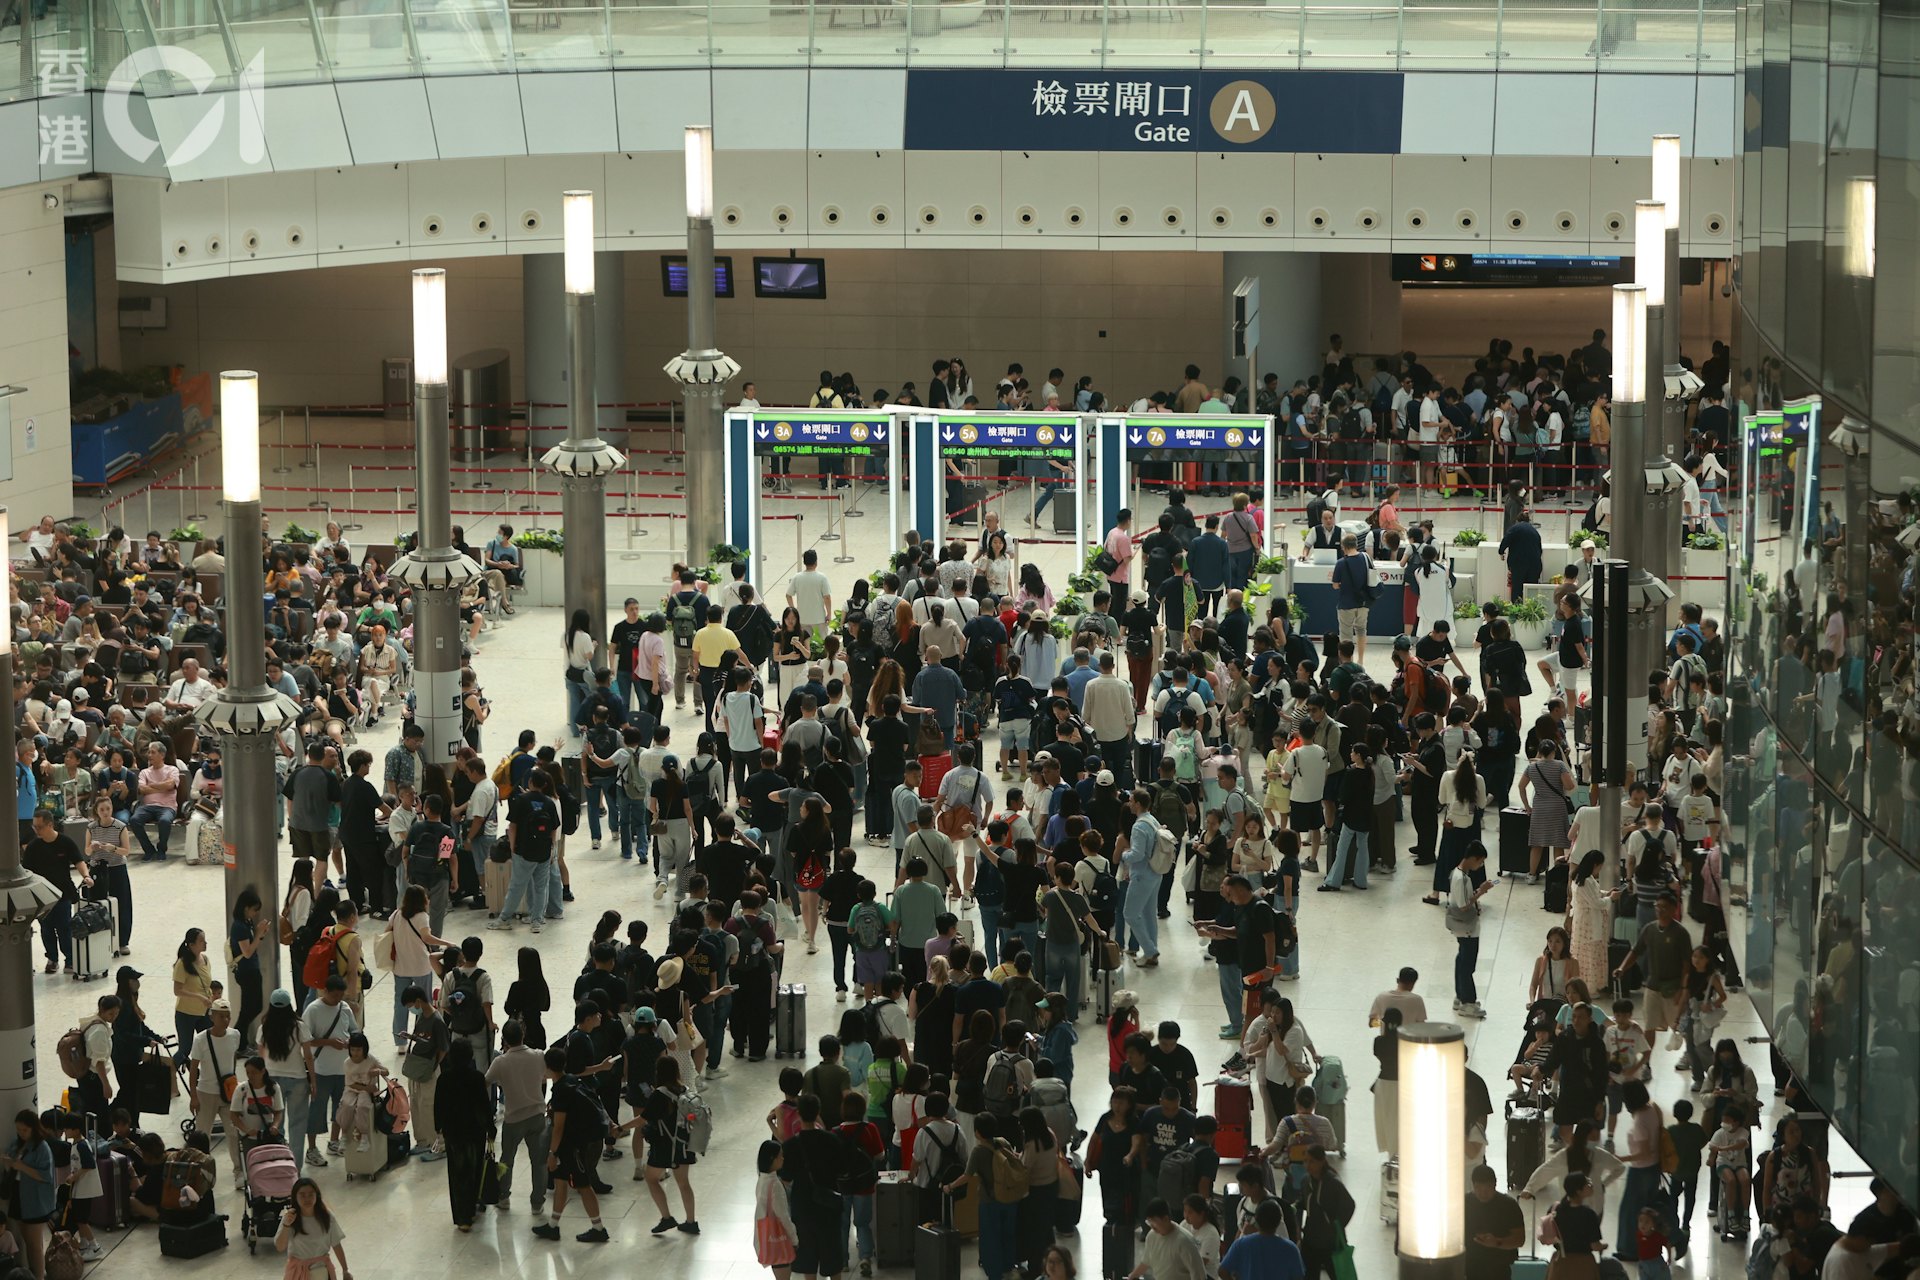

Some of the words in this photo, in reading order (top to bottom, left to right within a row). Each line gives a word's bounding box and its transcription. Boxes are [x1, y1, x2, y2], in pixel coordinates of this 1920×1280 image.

[1031, 80, 1192, 117] 檢票閘口
[1224, 90, 1260, 131] A
[1135, 122, 1190, 142] Gate
[1443, 258, 1456, 269] 3A
[776, 426, 790, 437] 3A
[802, 423, 841, 434] 檢票閘口
[852, 427, 867, 438] 4A
[962, 428, 976, 440] 5A
[987, 426, 1027, 437] 檢票閘口
[1039, 429, 1053, 441] 6A
[1150, 431, 1164, 443] 7A
[1175, 428, 1215, 440] 檢票閘口
[1227, 432, 1242, 443] 8A
[773, 445, 796, 454] G6574
[813, 446, 843, 454] Shantou
[942, 447, 966, 455] G6540
[990, 448, 1044, 458] Guangzhounan
[1156, 1123, 1177, 1133] CALL
[1157, 1130, 1174, 1139] THE
